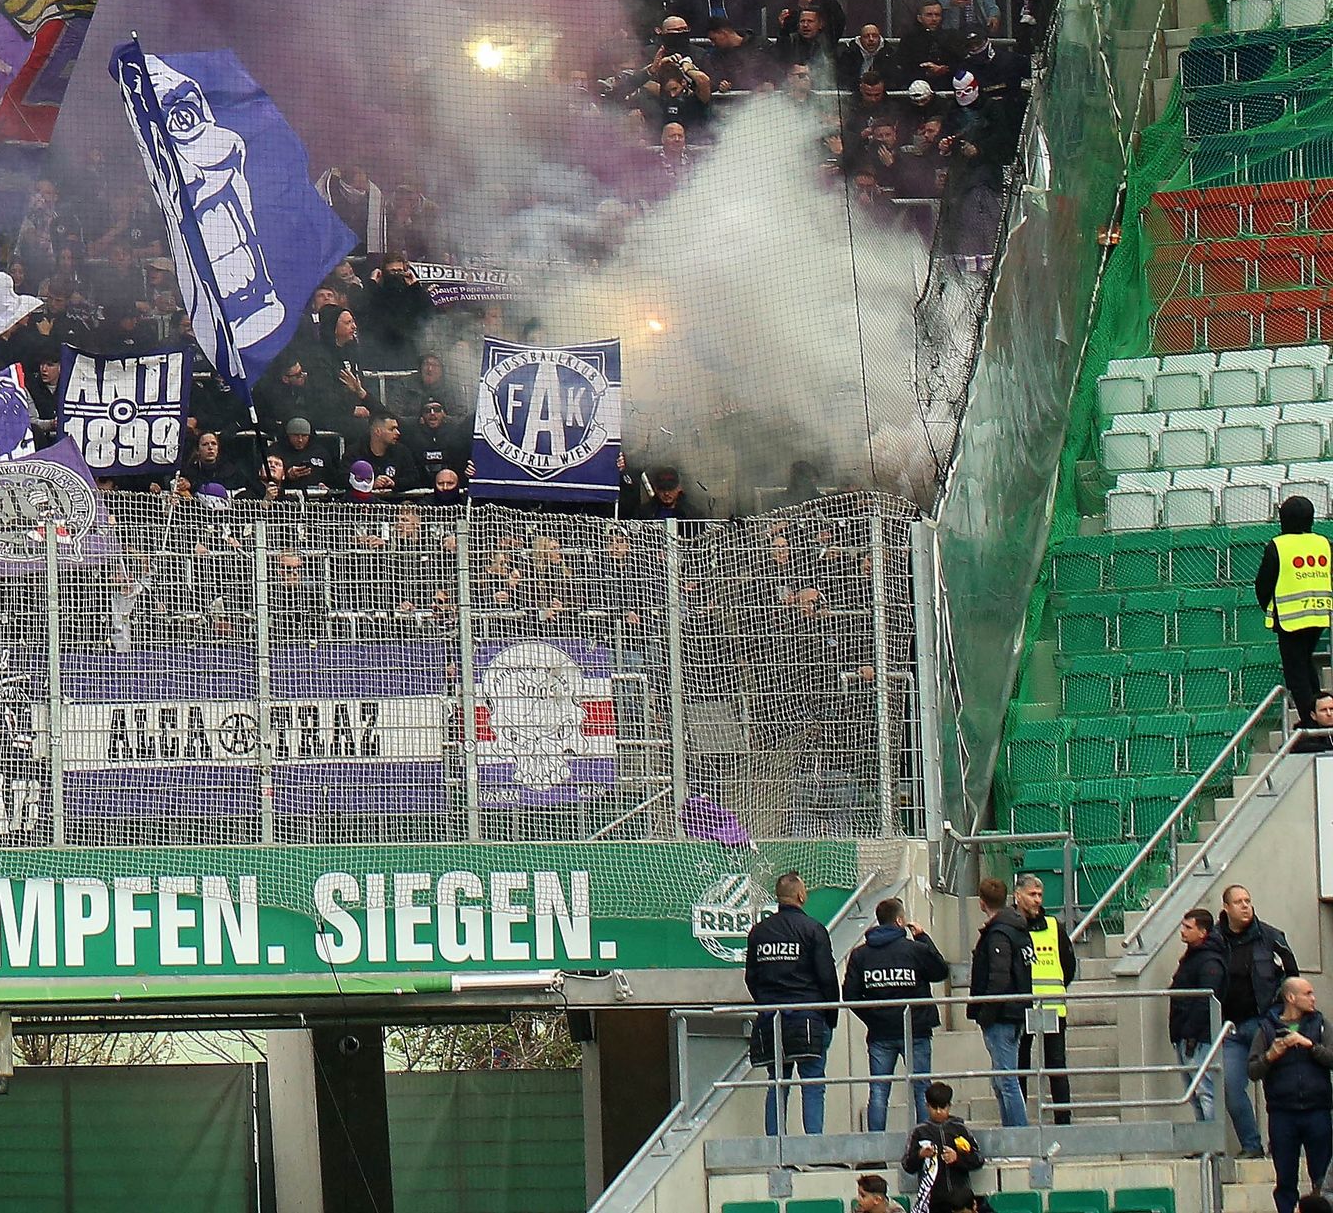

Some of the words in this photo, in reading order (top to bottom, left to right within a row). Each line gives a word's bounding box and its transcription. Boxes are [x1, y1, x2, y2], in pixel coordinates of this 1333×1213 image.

[65, 352, 183, 404] ANTI
[496, 351, 598, 385] FUSSBALLKLUB
[63, 416, 181, 468] 1899
[497, 439, 551, 468] AUSTRIA
[559, 441, 593, 466] WIEN
[313, 870, 618, 964] SIEGEN.
[757, 943, 800, 956] POLIZEI
[864, 969, 916, 982] POLIZEI
